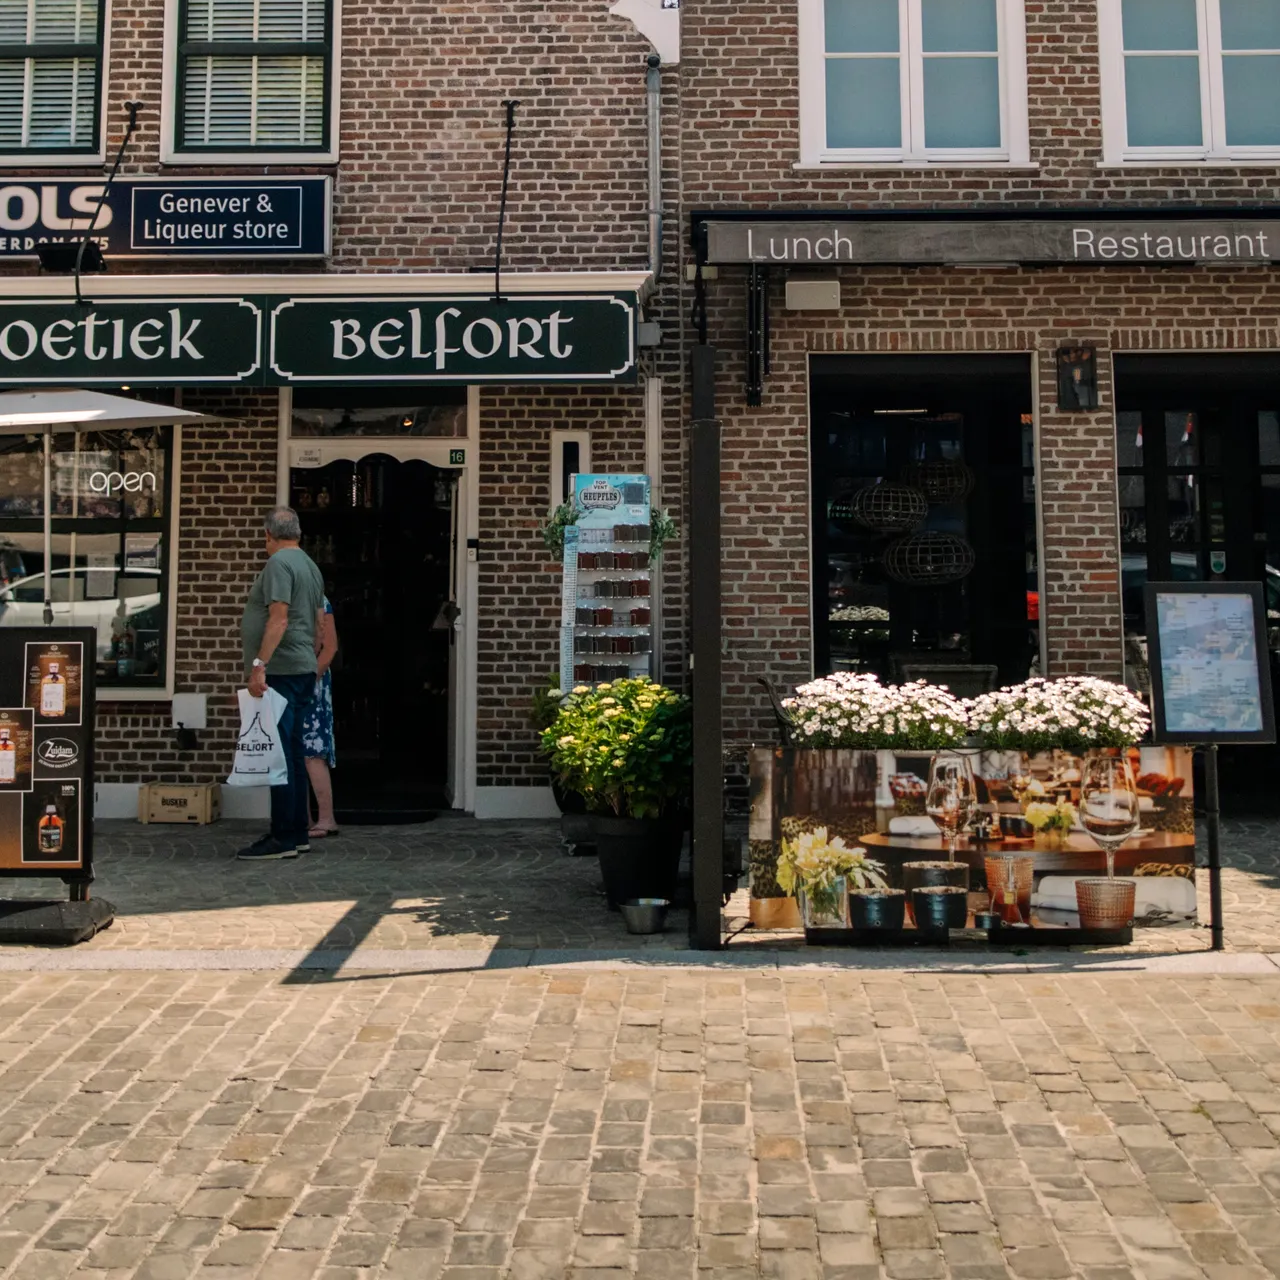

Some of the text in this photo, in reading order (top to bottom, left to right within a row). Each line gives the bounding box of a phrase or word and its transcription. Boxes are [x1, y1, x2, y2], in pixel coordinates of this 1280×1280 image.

[159, 193, 274, 214] Genever &
[144, 219, 289, 244] Liqueur store
[747, 228, 853, 261] Lunch
[1072, 228, 1270, 260] Restaurant
[451, 451, 464, 463] 16
[89, 471, 157, 498] open
[583, 492, 618, 501] HEUPFLES
[45, 740, 75, 758] Zuidam
